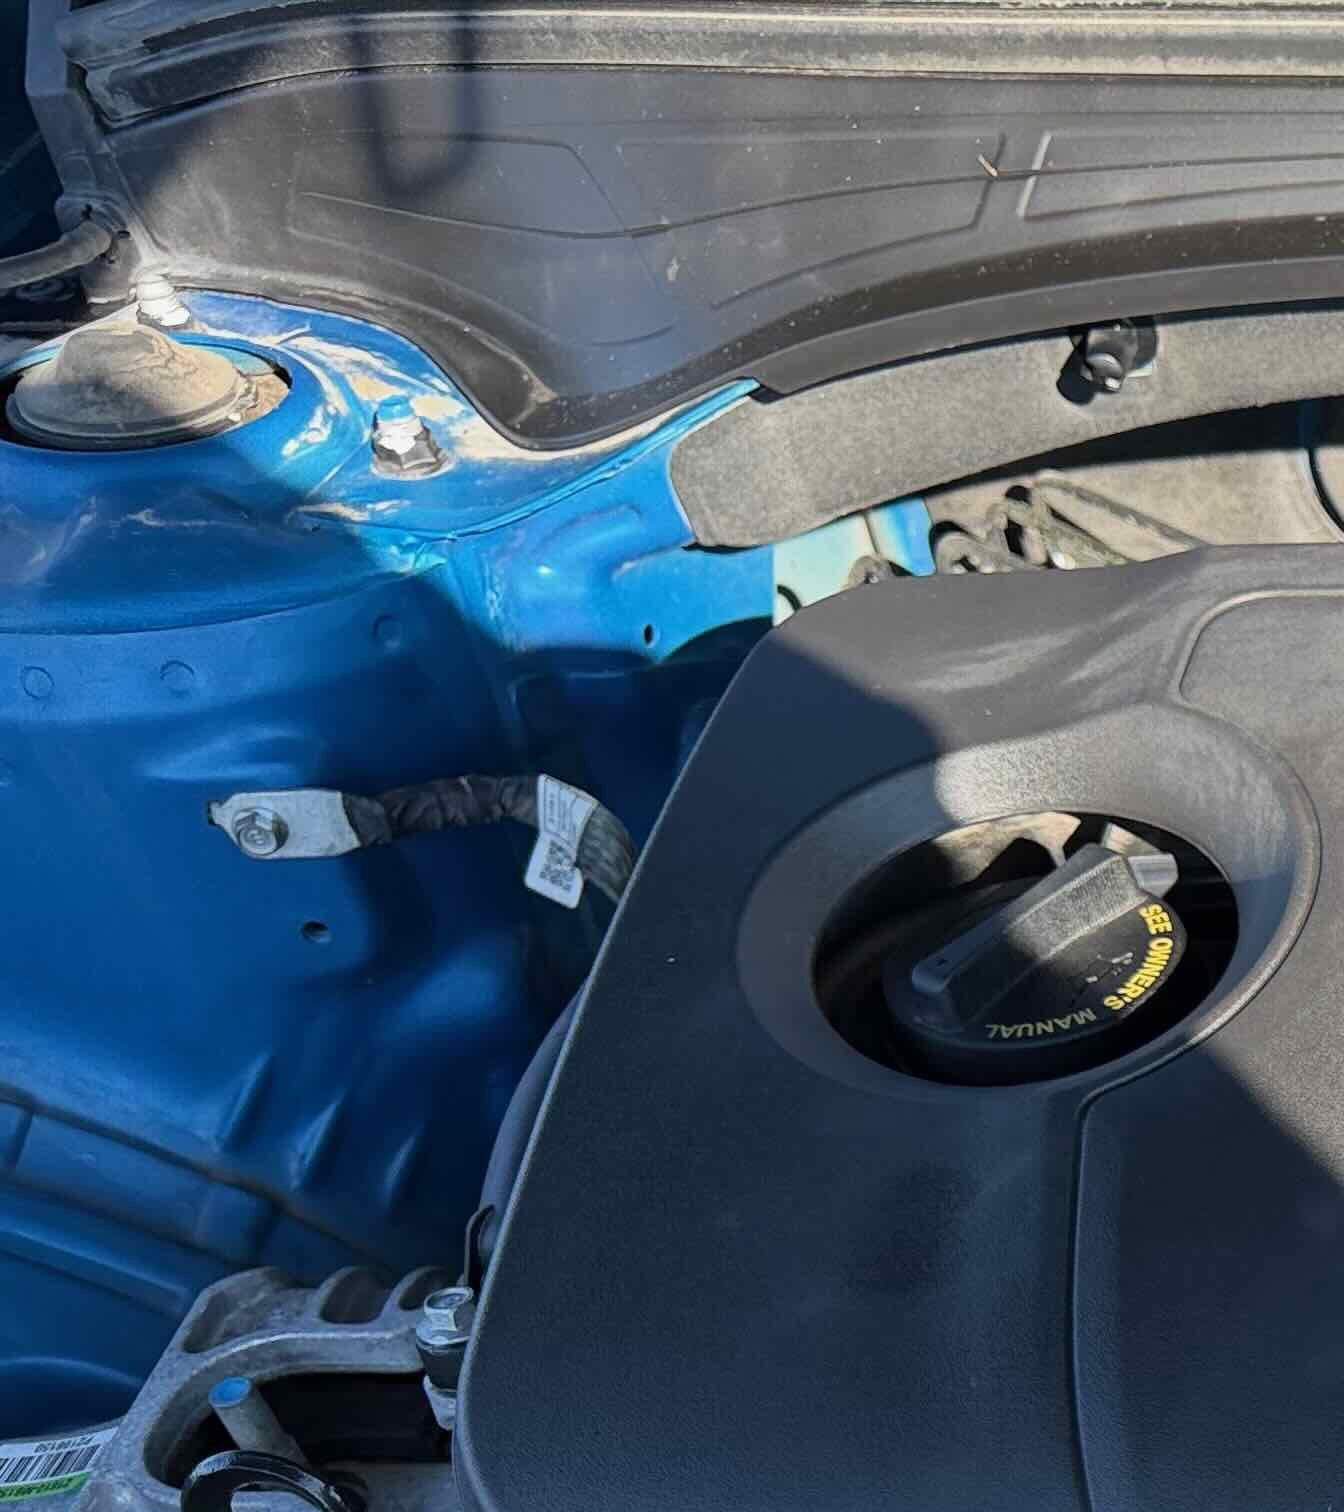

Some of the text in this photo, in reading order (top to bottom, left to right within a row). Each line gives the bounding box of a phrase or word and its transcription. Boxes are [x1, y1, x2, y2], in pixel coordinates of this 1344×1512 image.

[985, 903, 1173, 1039] SEE OWNER'S MANUAL
